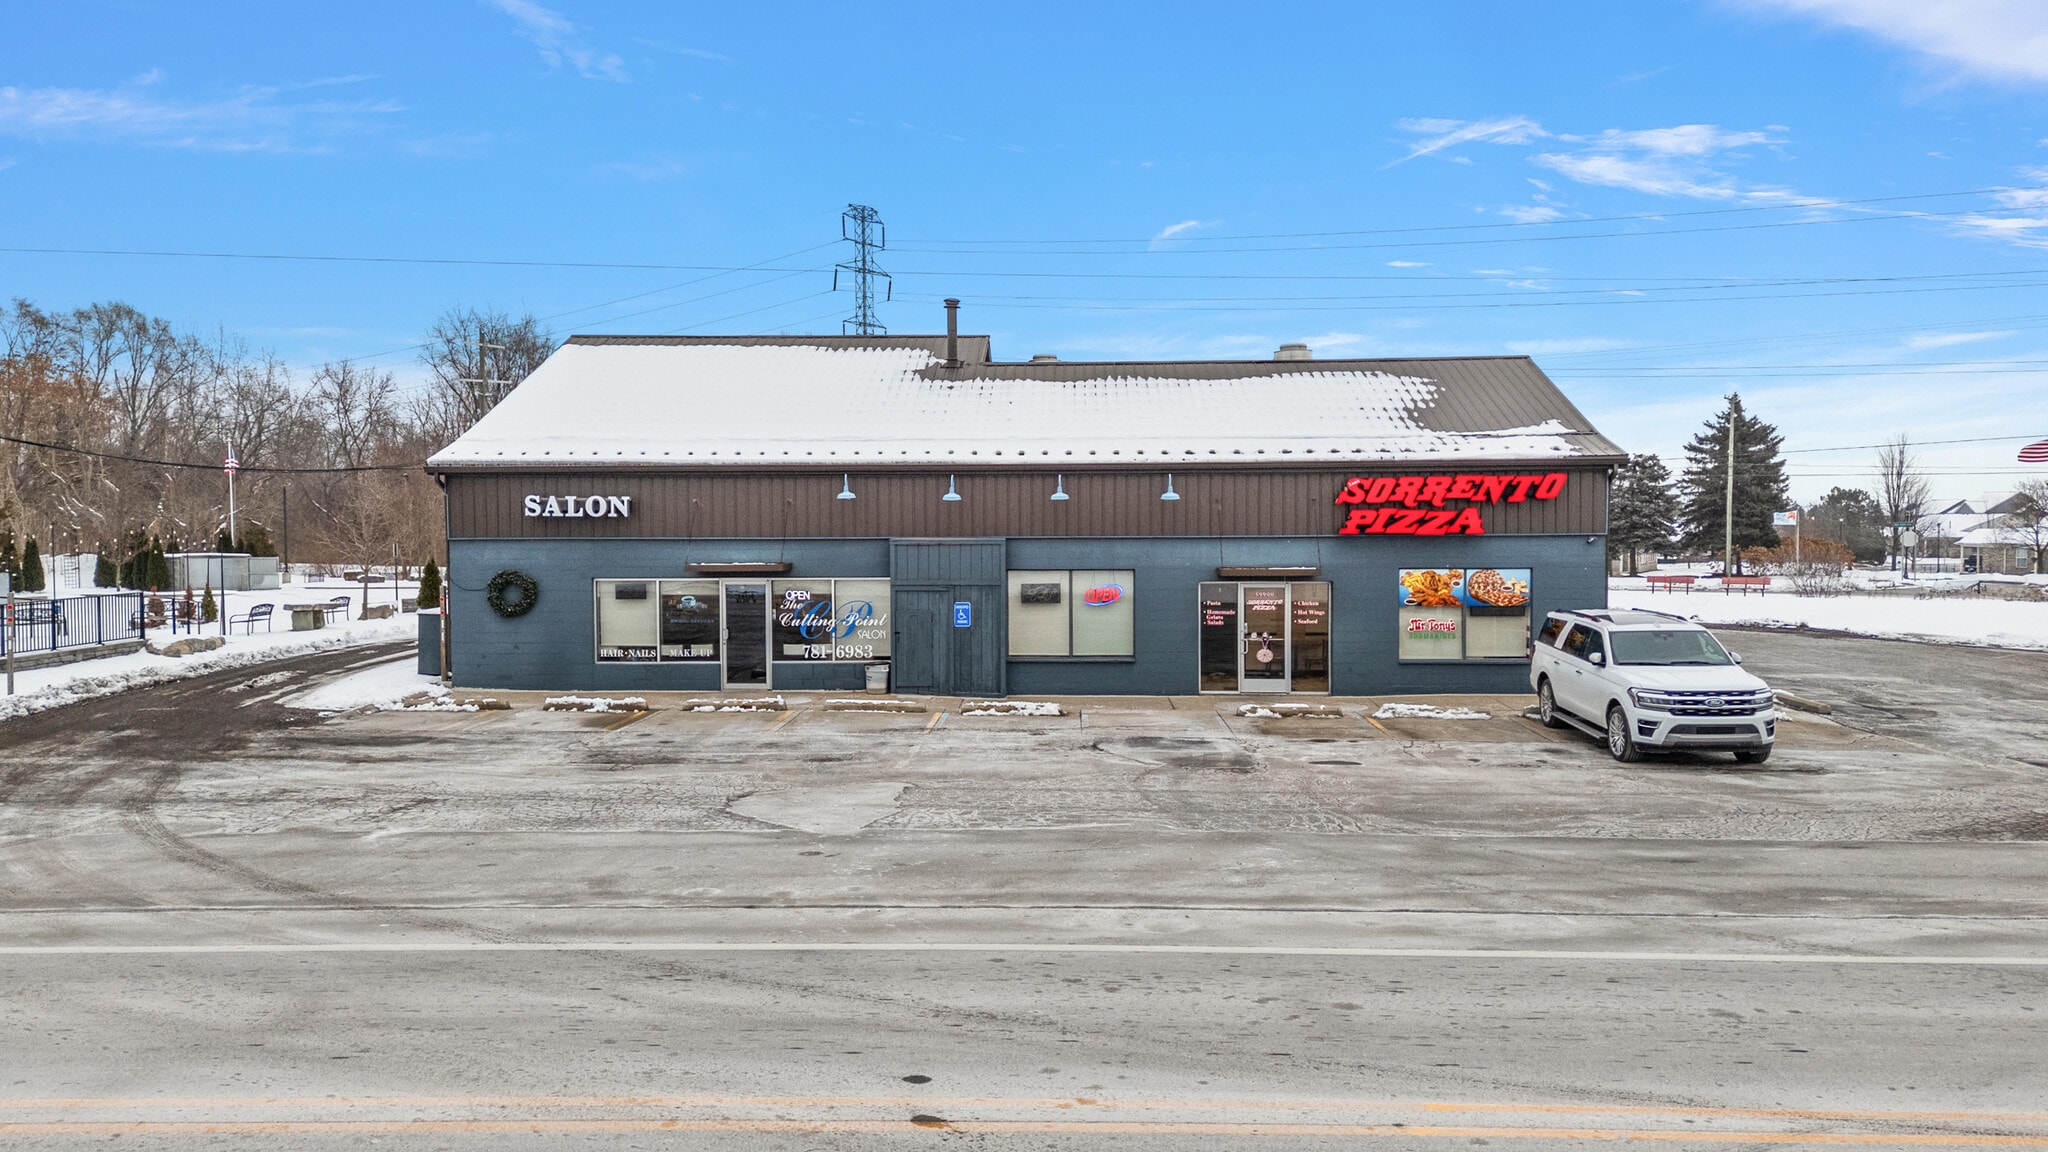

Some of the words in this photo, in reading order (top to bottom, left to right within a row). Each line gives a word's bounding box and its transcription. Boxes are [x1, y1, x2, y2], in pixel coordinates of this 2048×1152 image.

[1335, 473, 1568, 508] SORRENTO
[524, 495, 631, 517] SALON
[1338, 507, 1485, 535] PIZZA
[785, 590, 811, 600] OPEN
[1084, 587, 1120, 603] OPEN
[780, 599, 804, 610] The
[779, 612, 838, 632] Cutting
[842, 612, 888, 627] Point
[1427, 618, 1456, 632] Tony's
[857, 629, 887, 639] SALON
[1408, 632, 1457, 640] SUBMARINES
[802, 644, 873, 658] 781-6983
